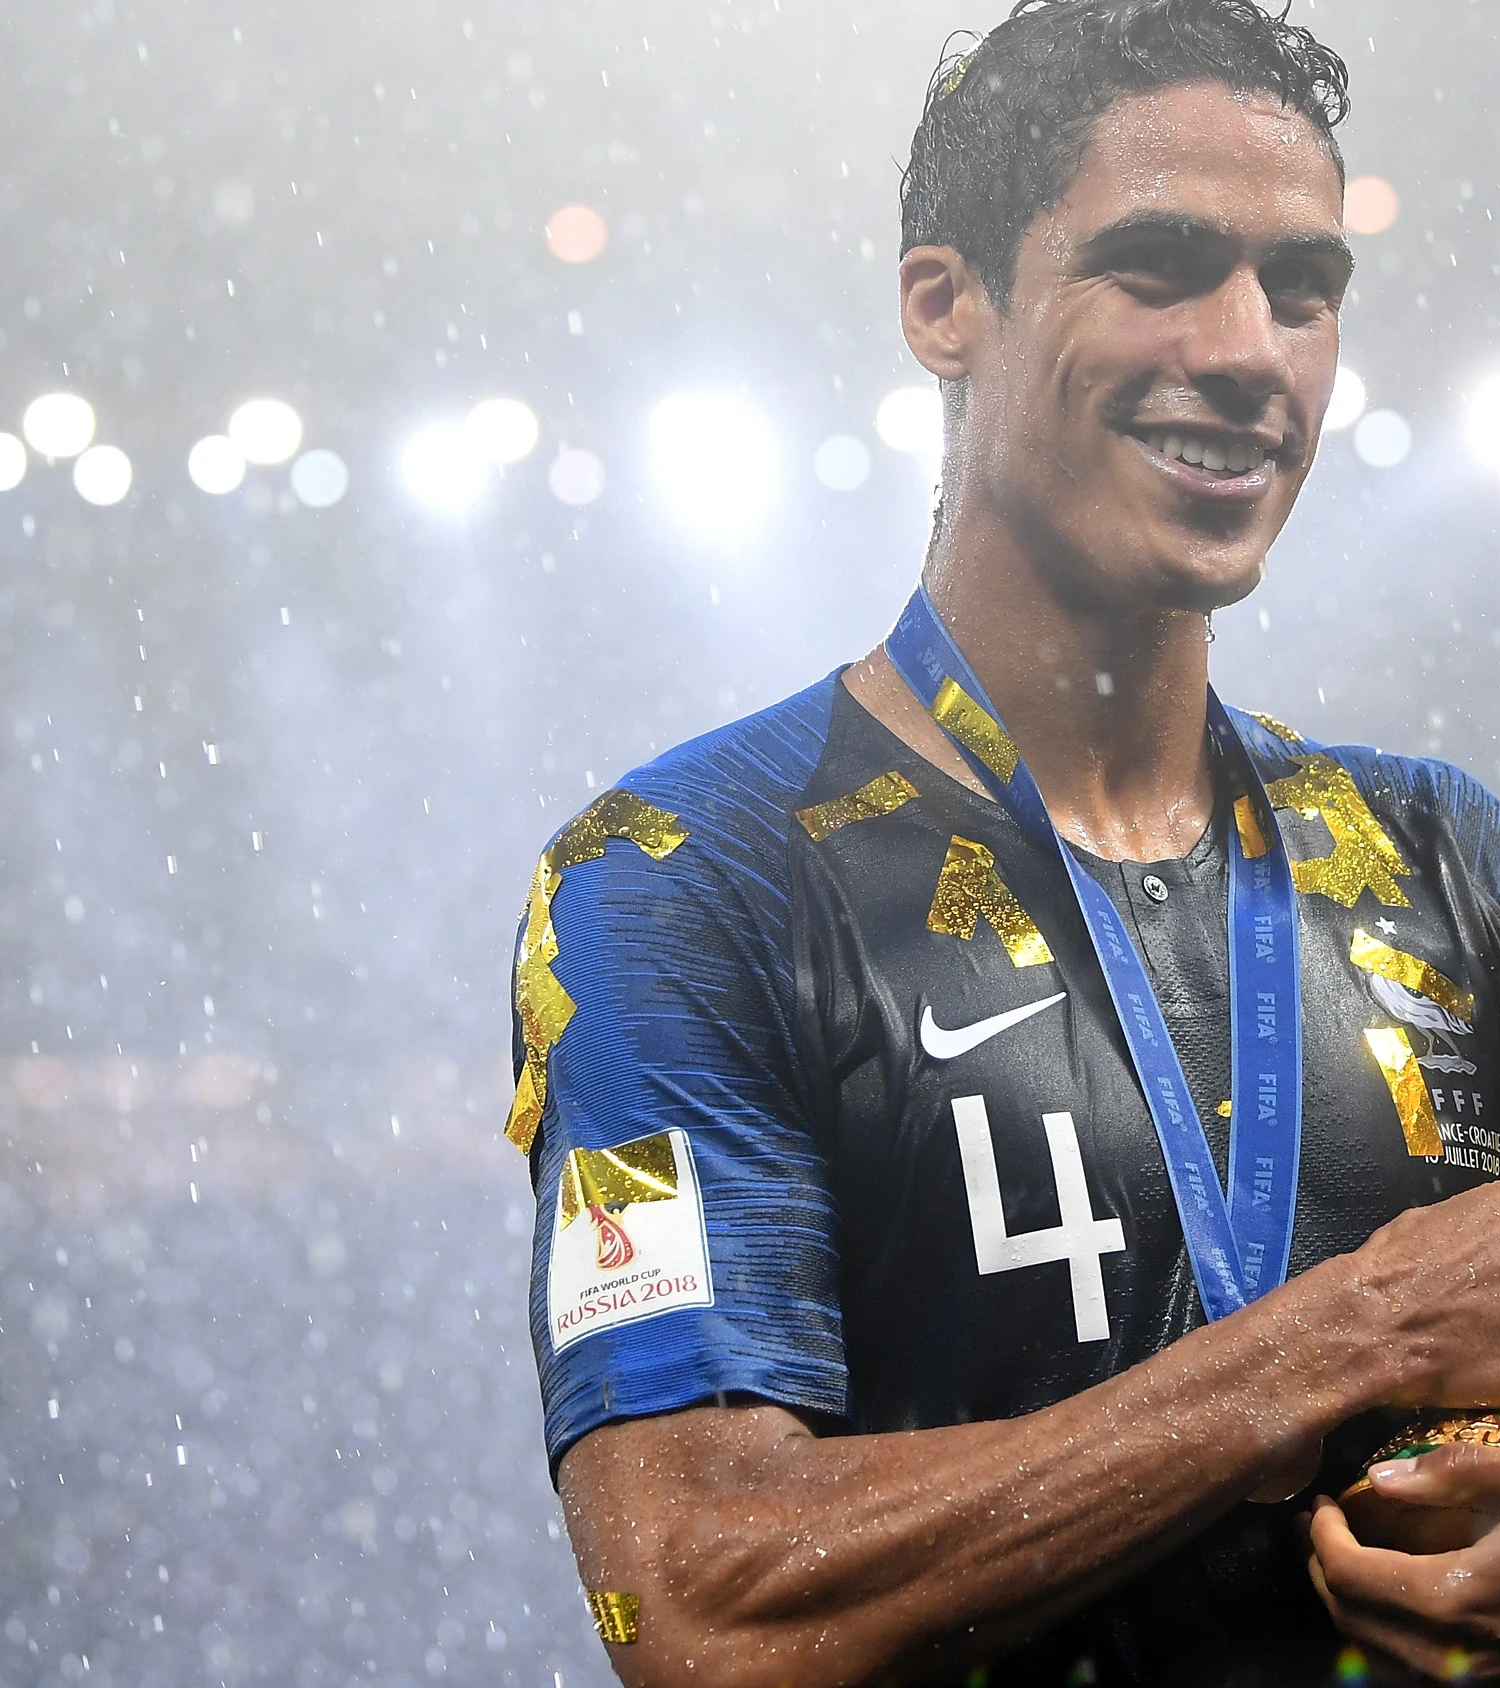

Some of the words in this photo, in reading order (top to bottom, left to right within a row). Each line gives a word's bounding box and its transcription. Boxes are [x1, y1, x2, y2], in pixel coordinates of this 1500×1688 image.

[1443, 1145, 1480, 1169] JUILLET
[1481, 1151, 1500, 1177] 2018
[950, 1094, 1127, 1343] 4
[557, 1288, 637, 1334] RUSSIA
[640, 1274, 698, 1302] 2018
[579, 1286, 600, 1300] FIFA
[600, 1274, 639, 1291] WORLD
[640, 1268, 661, 1280] CUP
